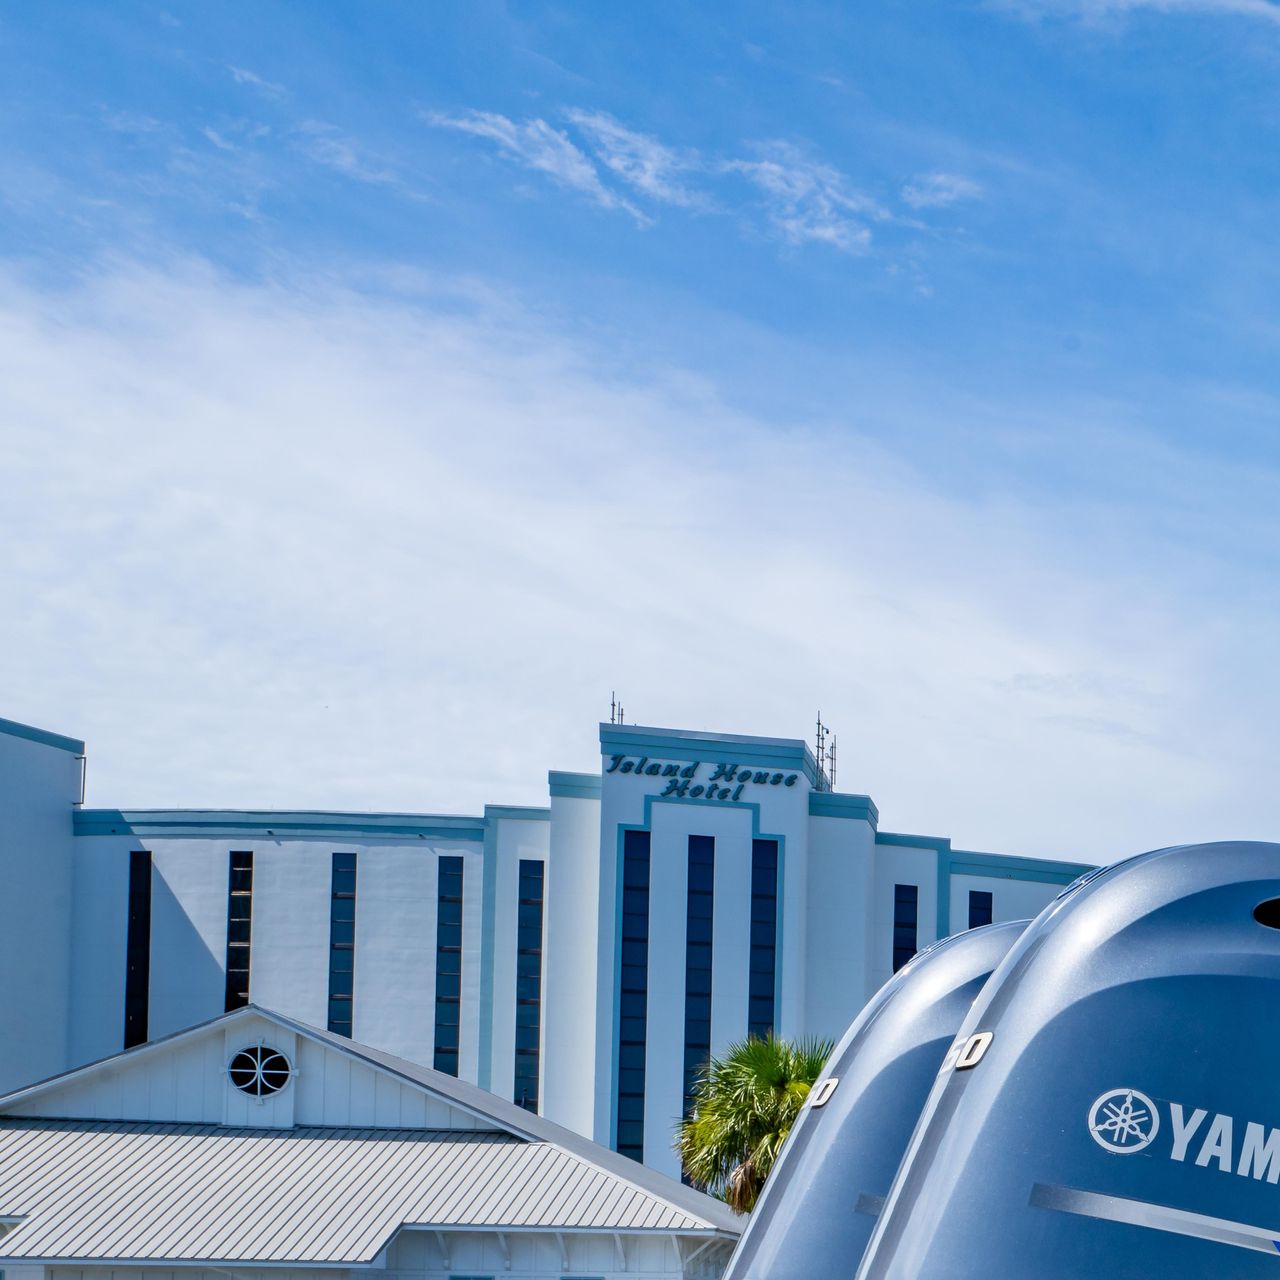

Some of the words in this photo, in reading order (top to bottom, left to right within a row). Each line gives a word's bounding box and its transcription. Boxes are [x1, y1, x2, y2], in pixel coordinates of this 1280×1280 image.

[606, 754, 700, 779] Island
[709, 762, 798, 787] House
[660, 779, 745, 801] Hotel
